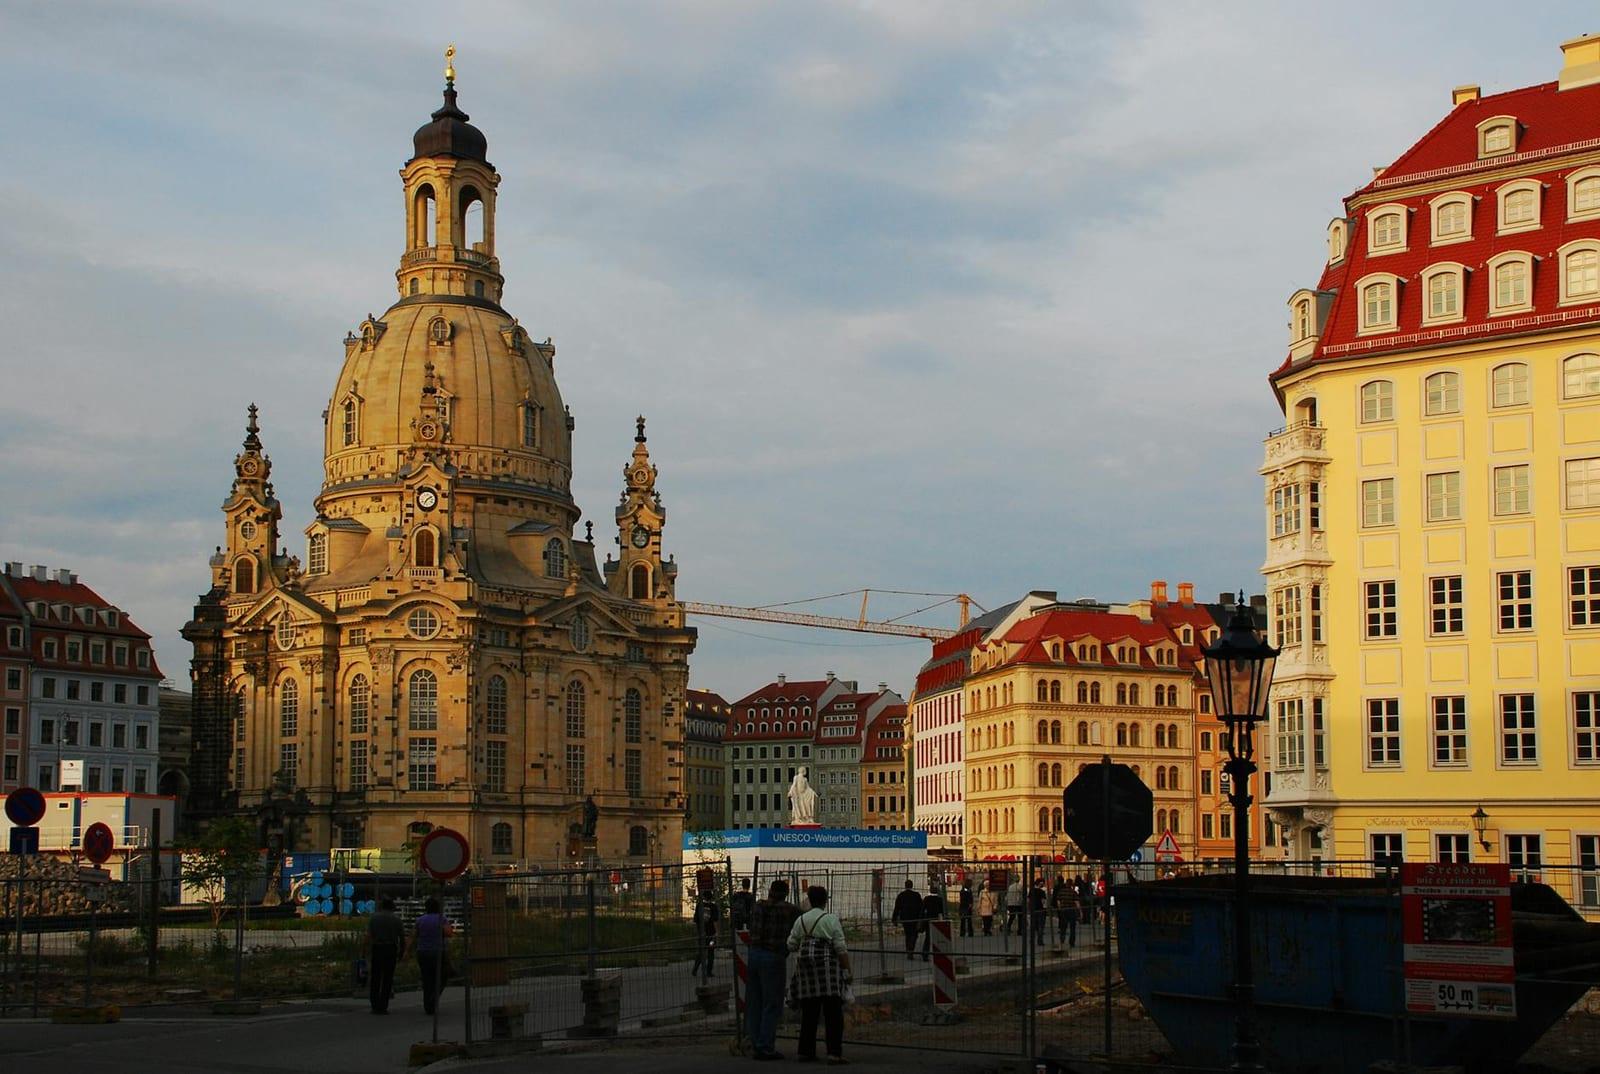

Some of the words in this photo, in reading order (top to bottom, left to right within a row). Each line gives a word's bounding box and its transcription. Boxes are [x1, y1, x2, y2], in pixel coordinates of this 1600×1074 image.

[772, 833, 849, 843] UNESCO-Welterbe
[851, 834, 890, 844] "Dresdner
[1425, 864, 1486, 875] Dresden
[1438, 984, 1455, 1001] 50
[1461, 989, 1473, 1001] m
